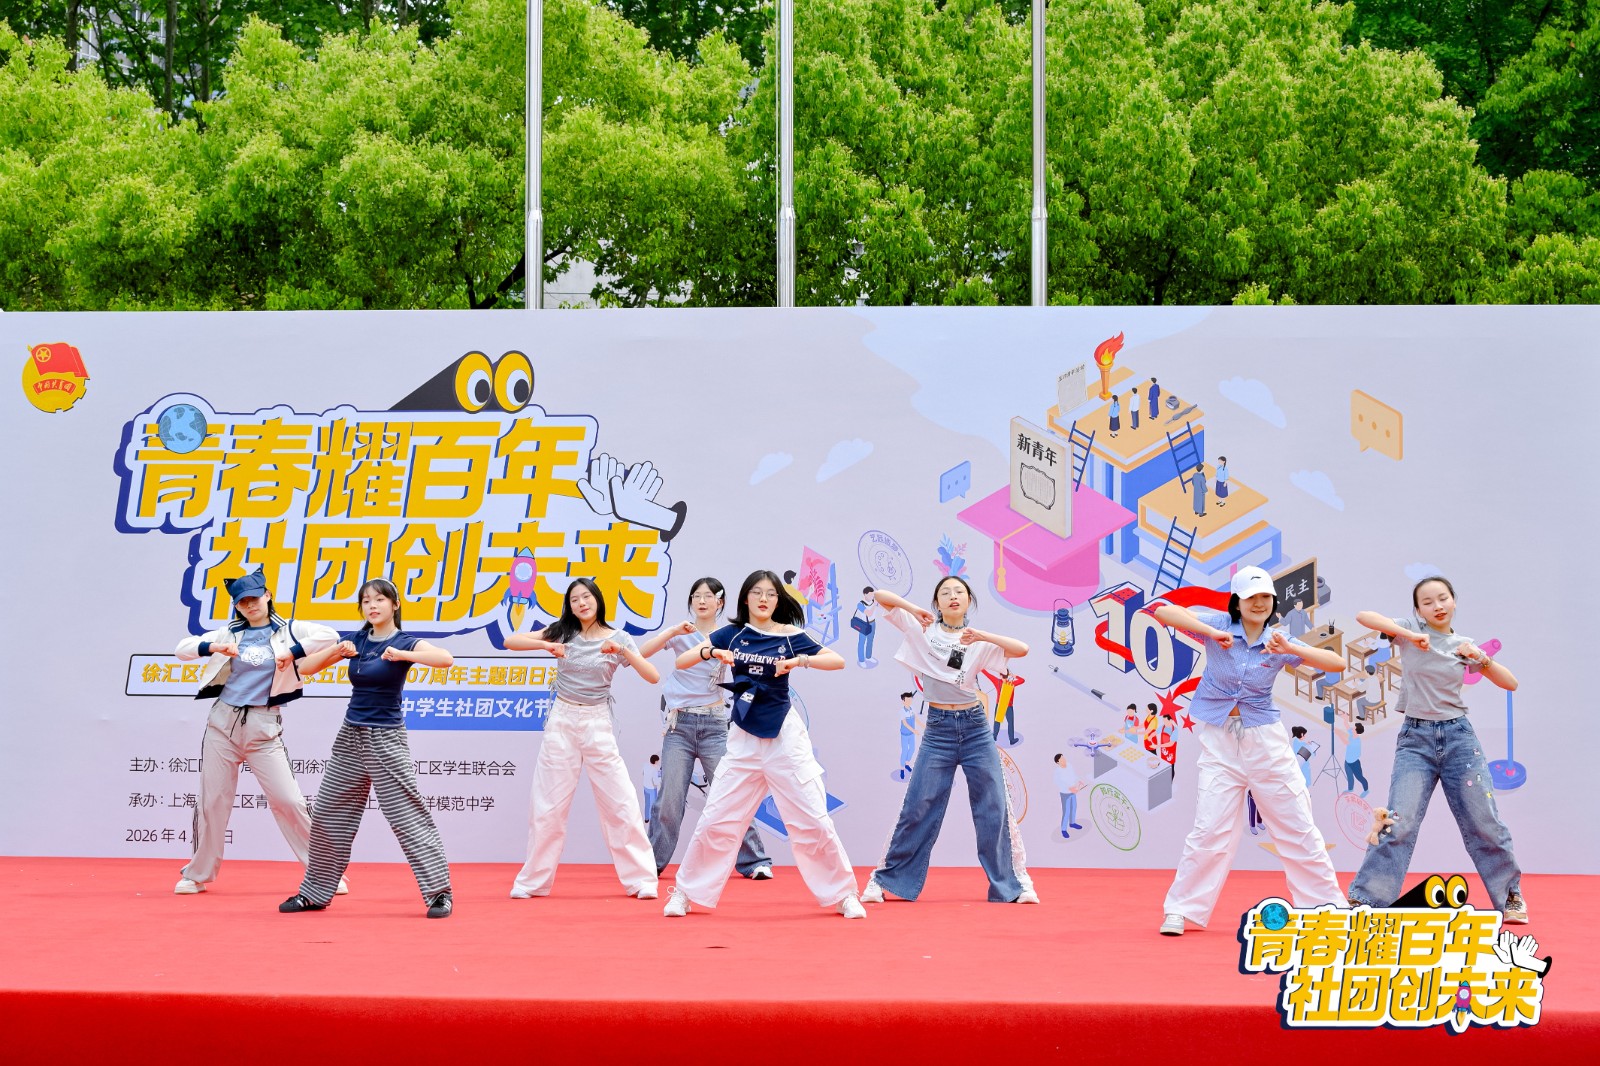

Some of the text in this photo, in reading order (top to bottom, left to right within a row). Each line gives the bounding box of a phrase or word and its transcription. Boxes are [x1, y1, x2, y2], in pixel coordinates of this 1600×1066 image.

[138, 418, 587, 518] 青春耀百年
[1016, 433, 1058, 467] 新青年
[205, 521, 660, 622] 社团创未来
